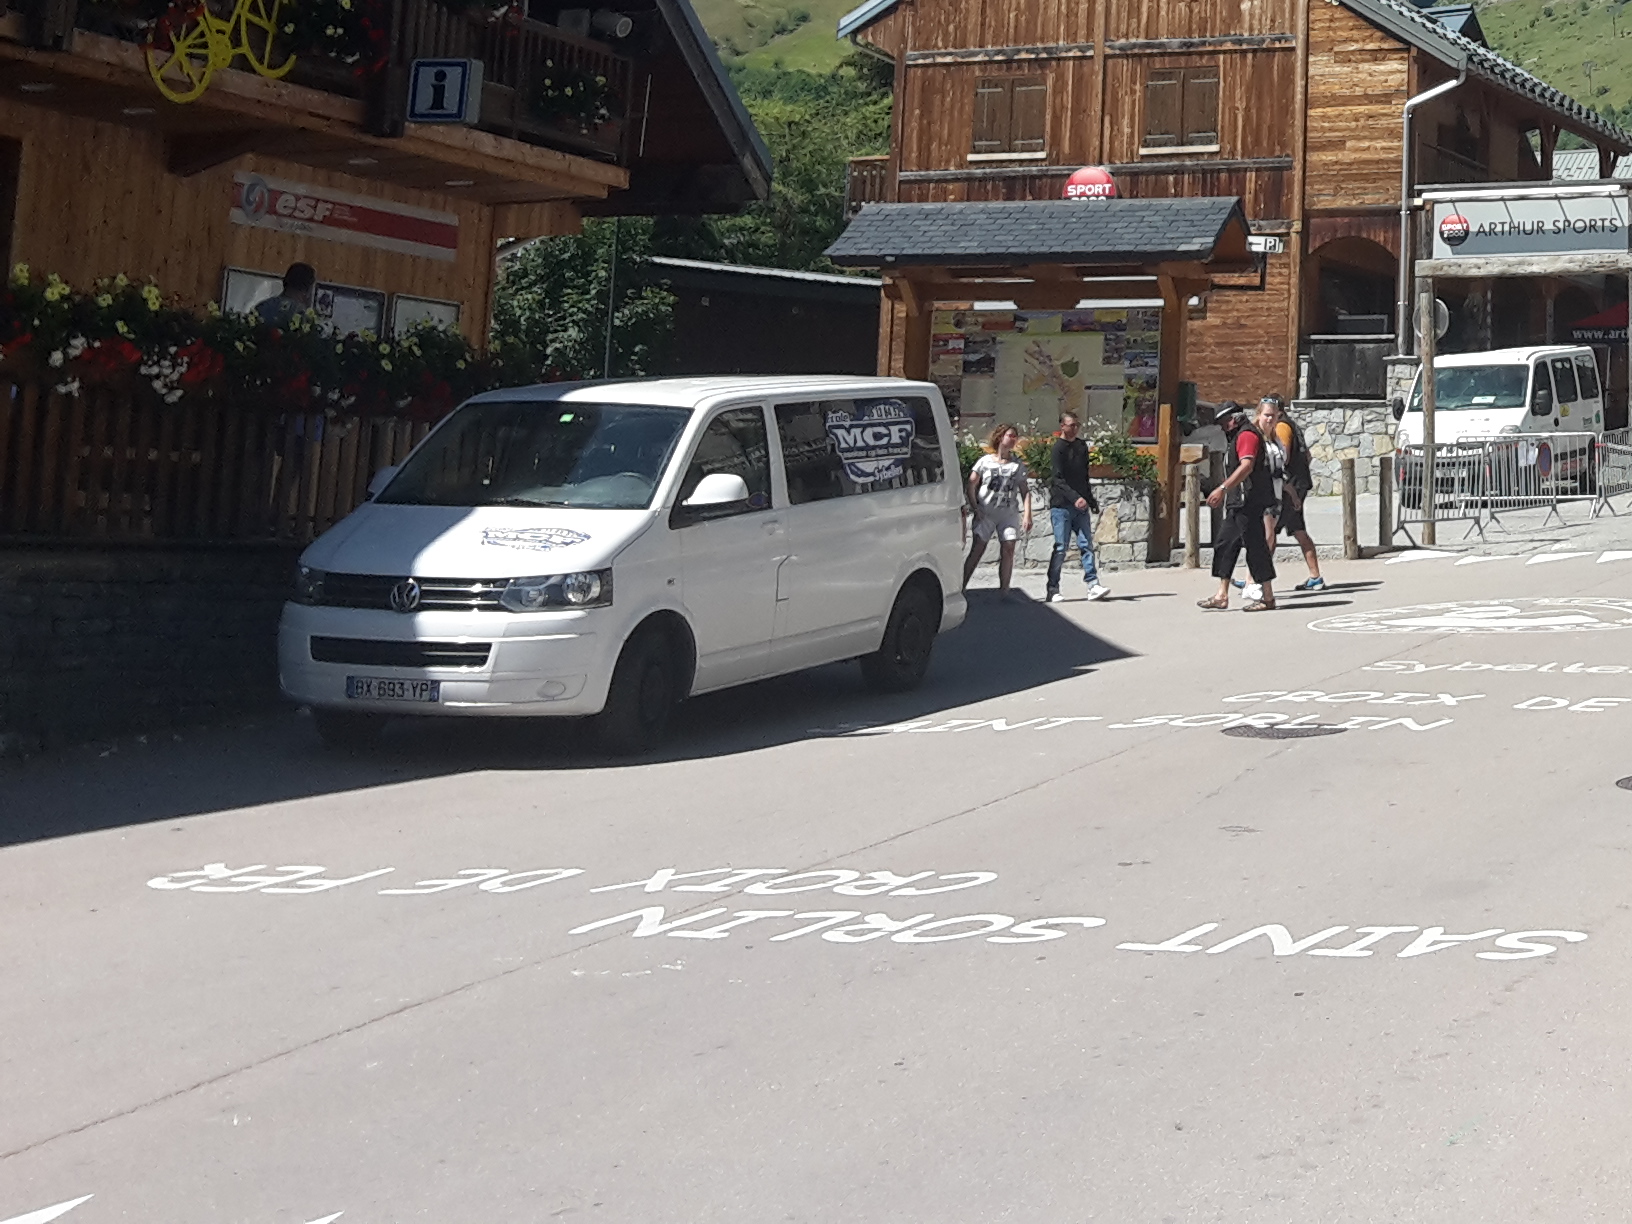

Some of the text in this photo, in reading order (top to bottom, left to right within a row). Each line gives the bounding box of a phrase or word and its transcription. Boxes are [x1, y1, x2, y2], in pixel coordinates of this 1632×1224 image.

[1067, 183, 1112, 196] SPORT
[1475, 217, 1619, 237] ARTHUR SPORTS
[831, 423, 912, 448] MCF
[1221, 690, 1486, 706] CROIX
[1512, 696, 1632, 712] DE
[1106, 713, 1455, 731] SORLIN
[146, 862, 999, 896] CROIX DE FER
[567, 906, 1588, 960] SAINT SORLIN
